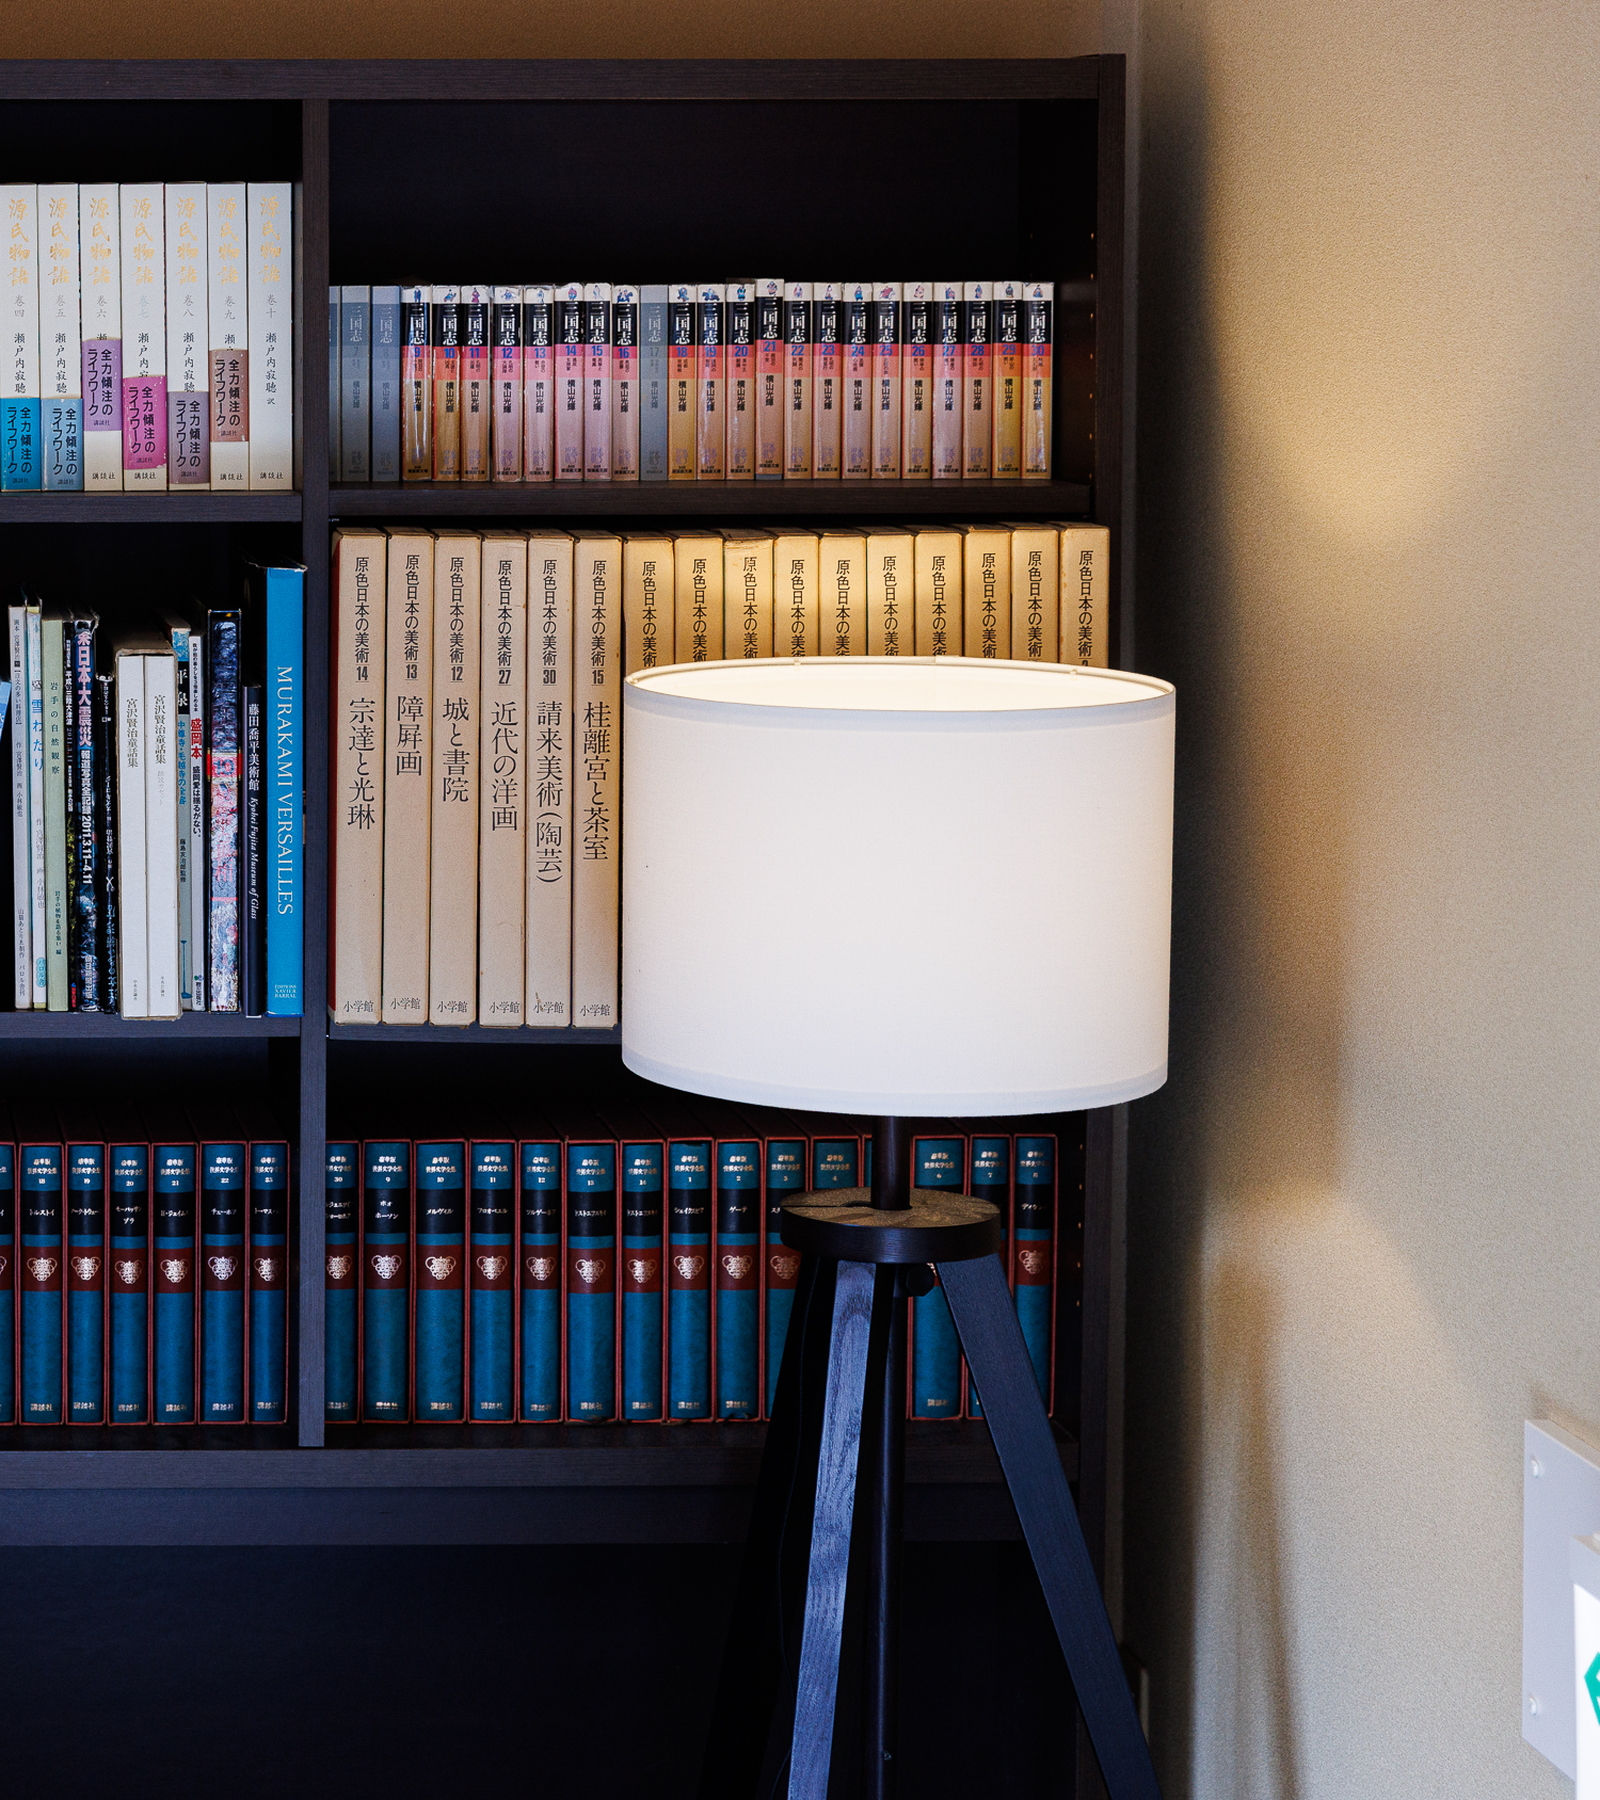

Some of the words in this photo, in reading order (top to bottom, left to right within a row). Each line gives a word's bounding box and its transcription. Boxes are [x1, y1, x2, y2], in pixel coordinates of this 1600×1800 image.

[7, 198, 31, 286] 源氏物語
[47, 197, 71, 286] 源氏物語
[88, 197, 111, 285] 源氏物語
[175, 197, 199, 285] 源氏物語
[258, 196, 282, 284] 源氏物語
[500, 303, 515, 345] 三国志
[501, 347, 513, 358] 12
[617, 302, 632, 345] 三国志
[734, 301, 749, 345] 三国志
[734, 346, 749, 357] 20
[791, 301, 806, 343] 三国志
[791, 345, 805, 356] 22
[911, 301, 927, 343] 三国志
[87, 349, 99, 416] ライフワーク
[101, 348, 113, 416] 全力傾注の
[215, 359, 227, 427] ライフワーク
[229, 359, 241, 427] 全力傾注の
[7, 406, 18, 474] ライフワーク
[20, 406, 32, 474] 全力傾注の
[355, 557, 369, 664] 原色日本の美術
[404, 554, 419, 661] 原色日本の美術
[450, 557, 464, 664] 原色日本の美術
[498, 560, 512, 667] 原色日本の美術
[542, 559, 557, 666] 原色日本の美術
[591, 560, 606, 666] 原色日本の美術
[642, 561, 657, 667] 原色日本の美術
[982, 553, 996, 658] 原色日本の美術
[1027, 550, 1043, 658] 原色日本の美術
[1078, 550, 1094, 657] 原色日本の美術
[277, 666, 293, 787] MURAKAMI
[348, 697, 375, 830] 宗達と光琳
[442, 697, 470, 802] 城と書院
[491, 701, 519, 831] 近代の洋画
[583, 701, 611, 860] 桂離宮と茶室
[277, 793, 293, 915] VERSAILLES
[343, 1000, 374, 1013] 小学館
[437, 1000, 468, 1013] 小学館
[489, 1001, 520, 1014] 小学館
[580, 1004, 611, 1017] 小学館
